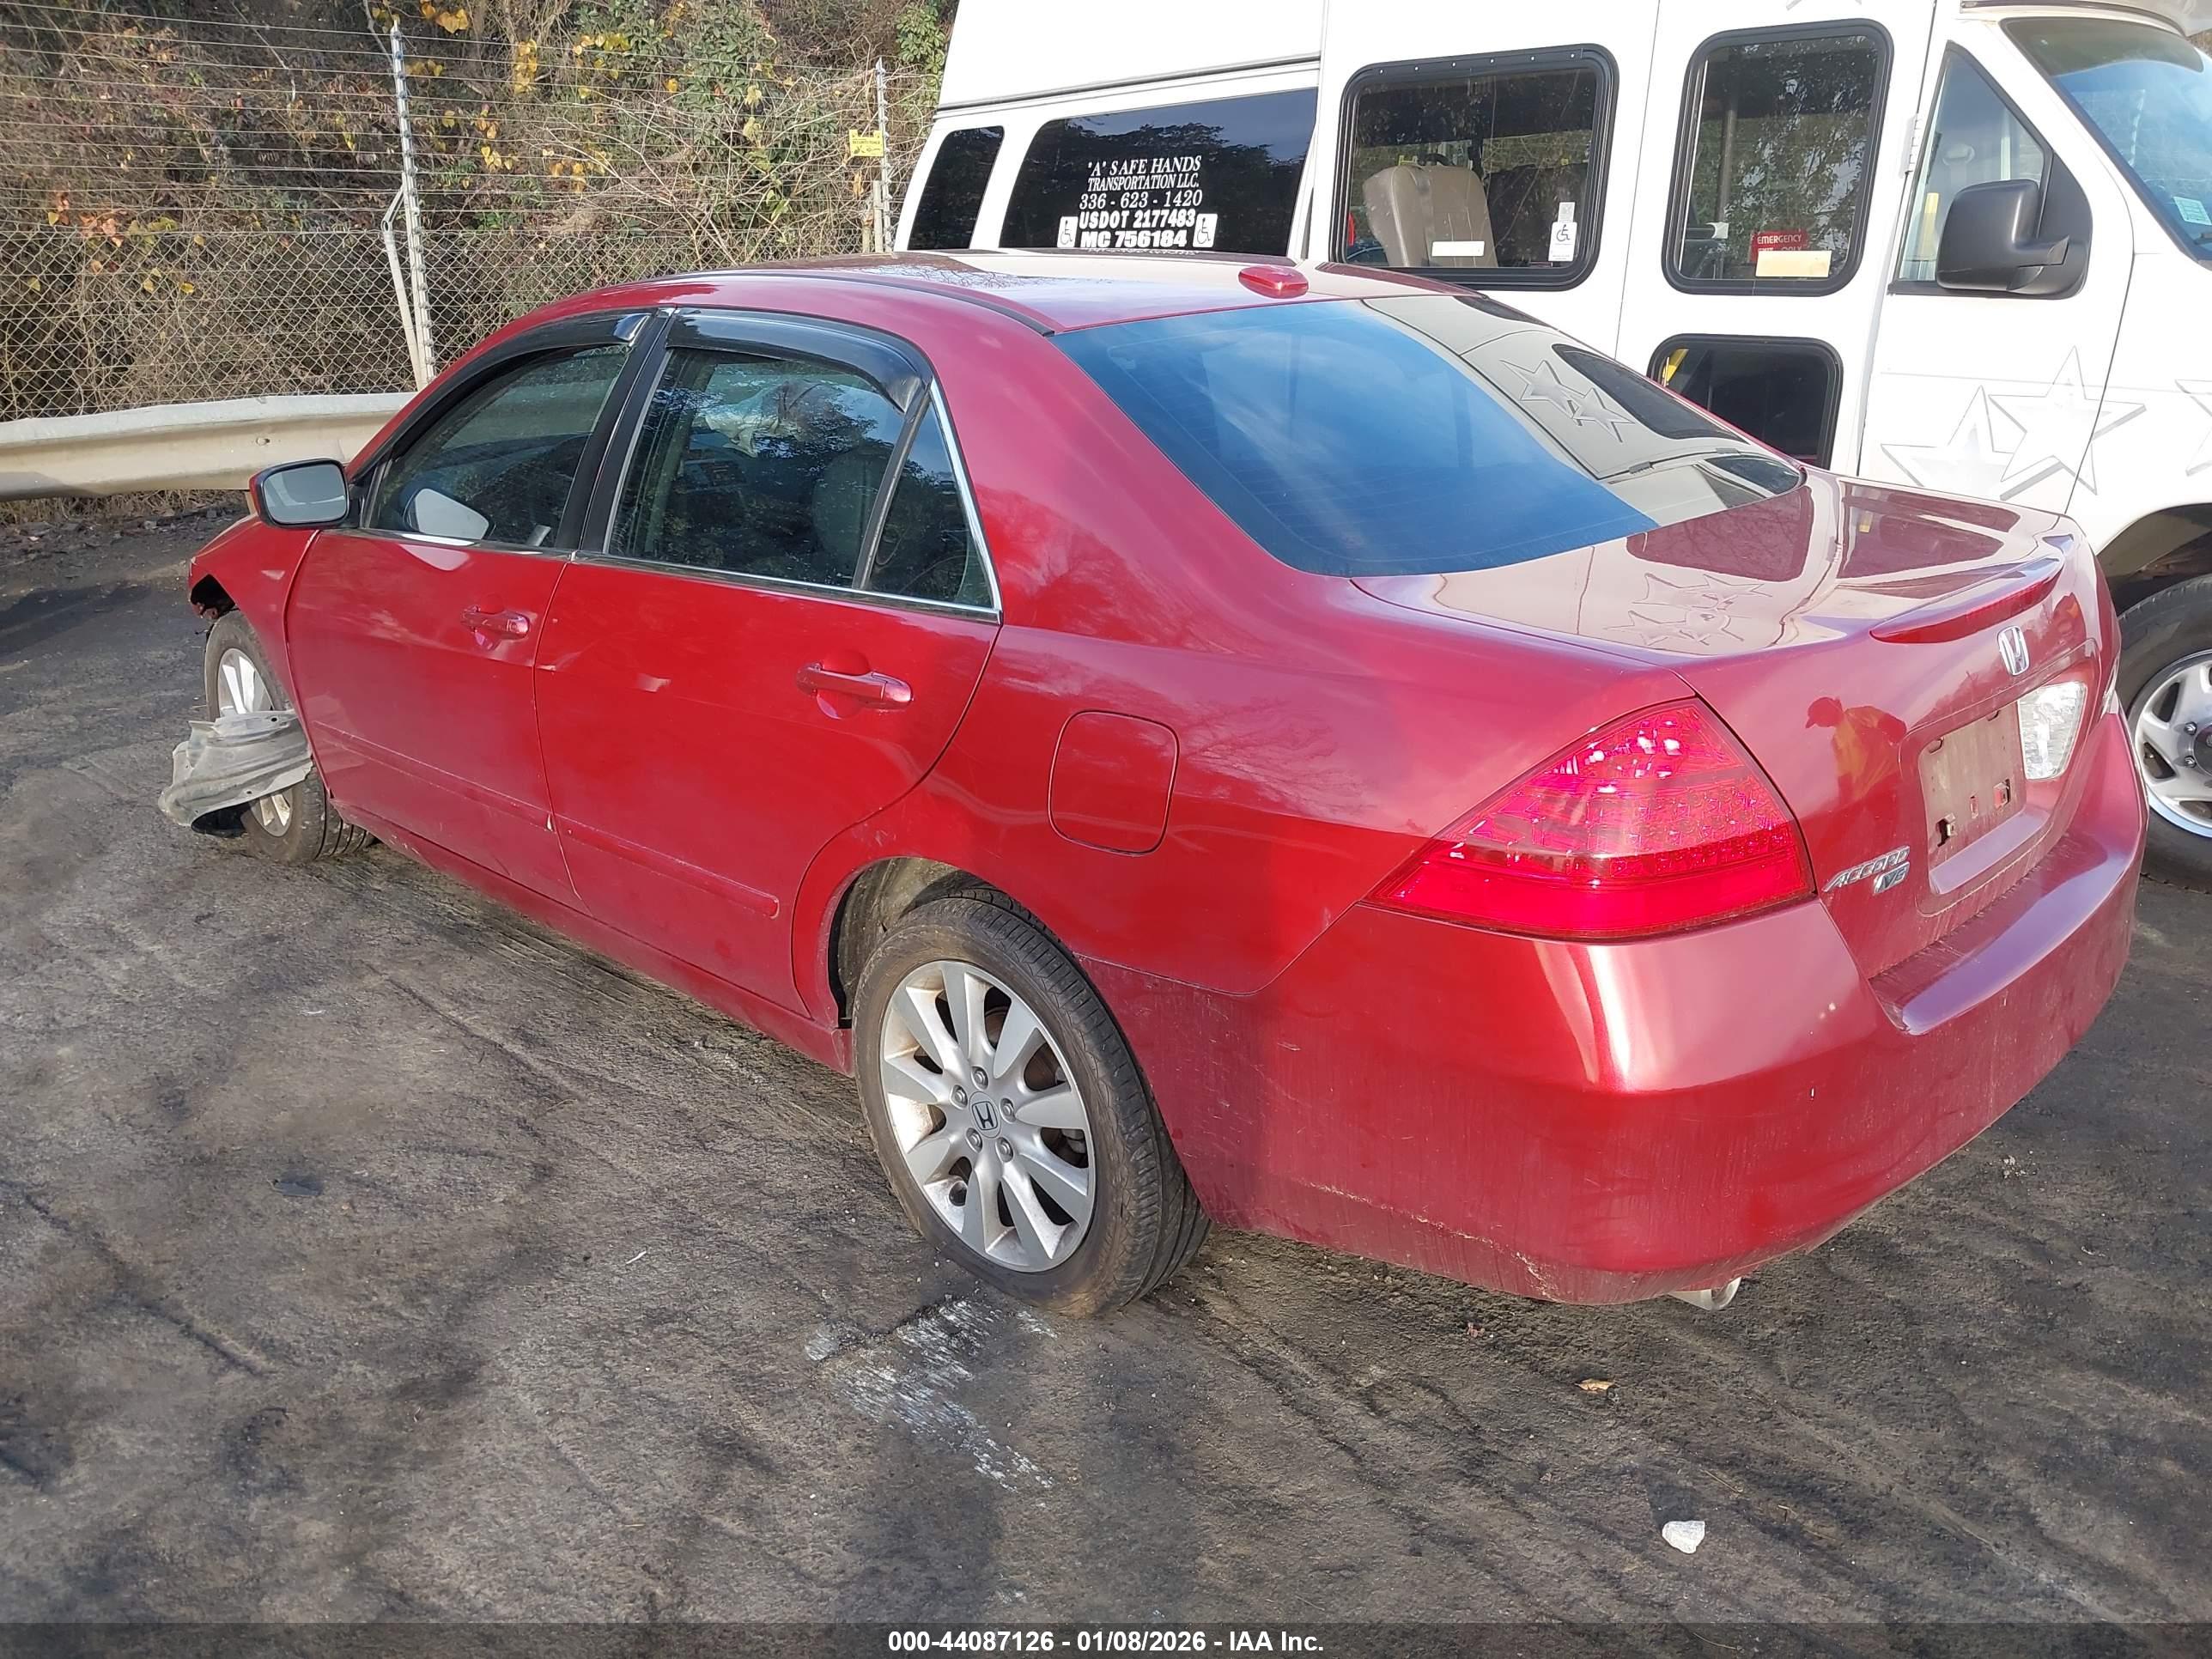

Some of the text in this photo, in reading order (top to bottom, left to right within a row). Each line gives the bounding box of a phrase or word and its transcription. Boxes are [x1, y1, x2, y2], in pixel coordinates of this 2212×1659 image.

[1109, 159, 1147, 175] SAFE
[1150, 155, 1201, 173] HANDS
[1087, 173, 1200, 191] TRANSPORTATION LLC.
[1079, 192, 1107, 210] 336
[1120, 191, 1148, 209] 623
[1164, 189, 1202, 207] 1420
[1079, 209, 1196, 229] USDOT 2177483
[1080, 229, 1188, 247] MC 756184
[1757, 234, 1802, 244] EMERGENCY
